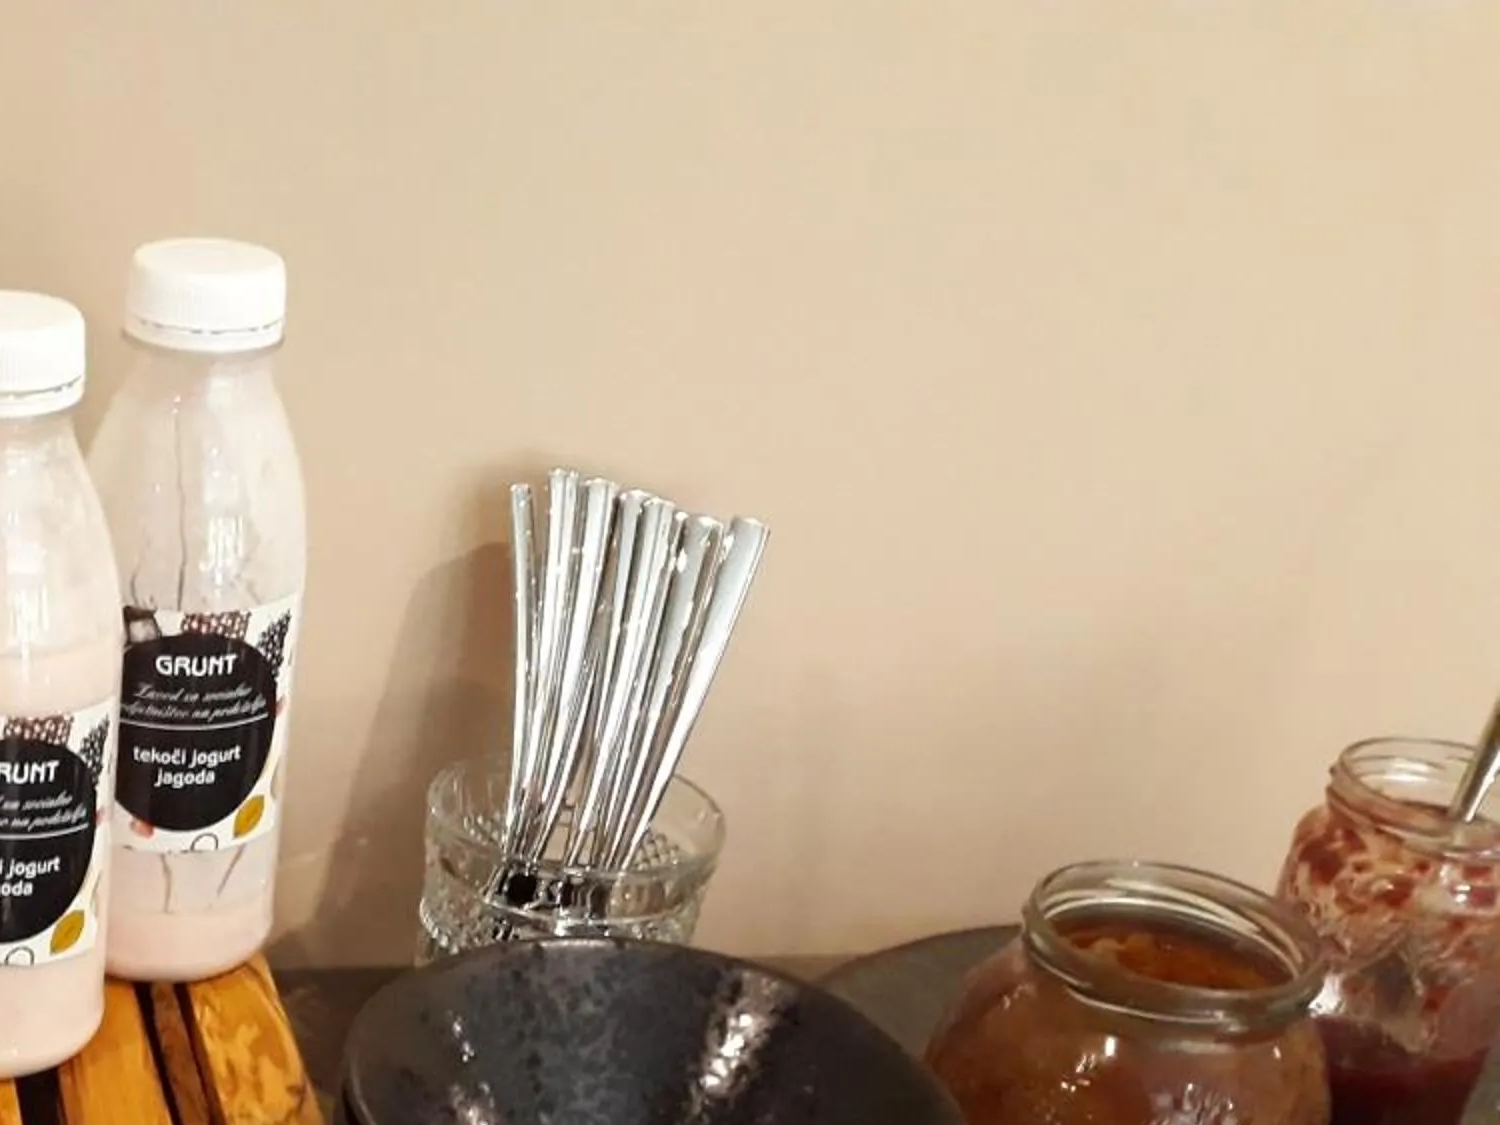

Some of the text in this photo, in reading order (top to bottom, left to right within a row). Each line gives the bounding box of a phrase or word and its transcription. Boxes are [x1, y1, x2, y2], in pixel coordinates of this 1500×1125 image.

[155, 655, 238, 677] GRUNT
[133, 745, 242, 768] tekoči jogurt
[154, 768, 216, 789] jagoda
[6, 855, 61, 879] jogurt
